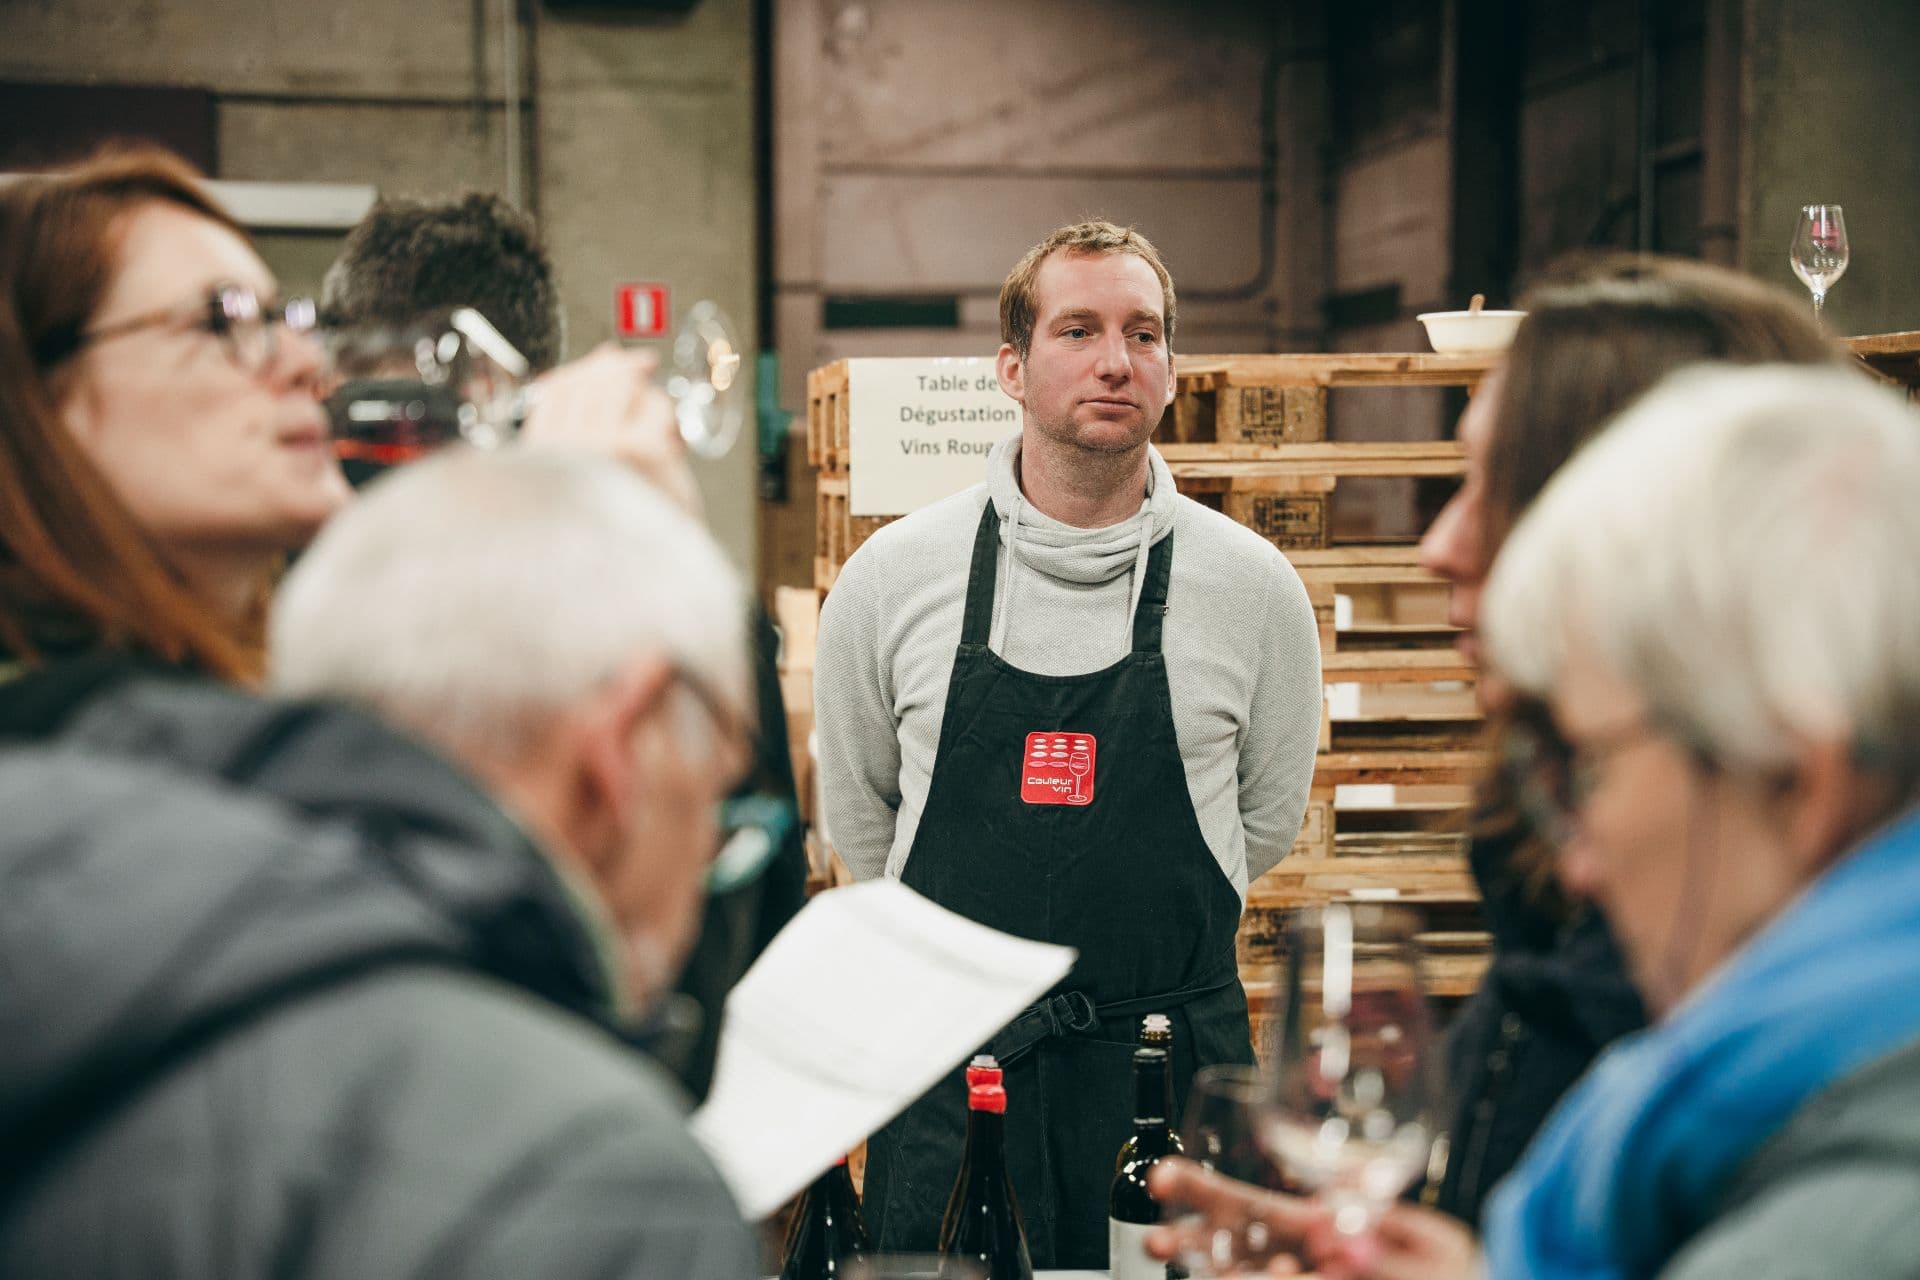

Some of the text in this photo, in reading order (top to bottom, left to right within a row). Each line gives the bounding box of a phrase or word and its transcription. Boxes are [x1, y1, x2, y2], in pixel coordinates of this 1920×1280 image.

[917, 375, 998, 392] Table de
[900, 405, 1016, 426] Dégustation
[900, 438, 994, 458] Vins Roug
[1027, 777, 1073, 785] Couleur
